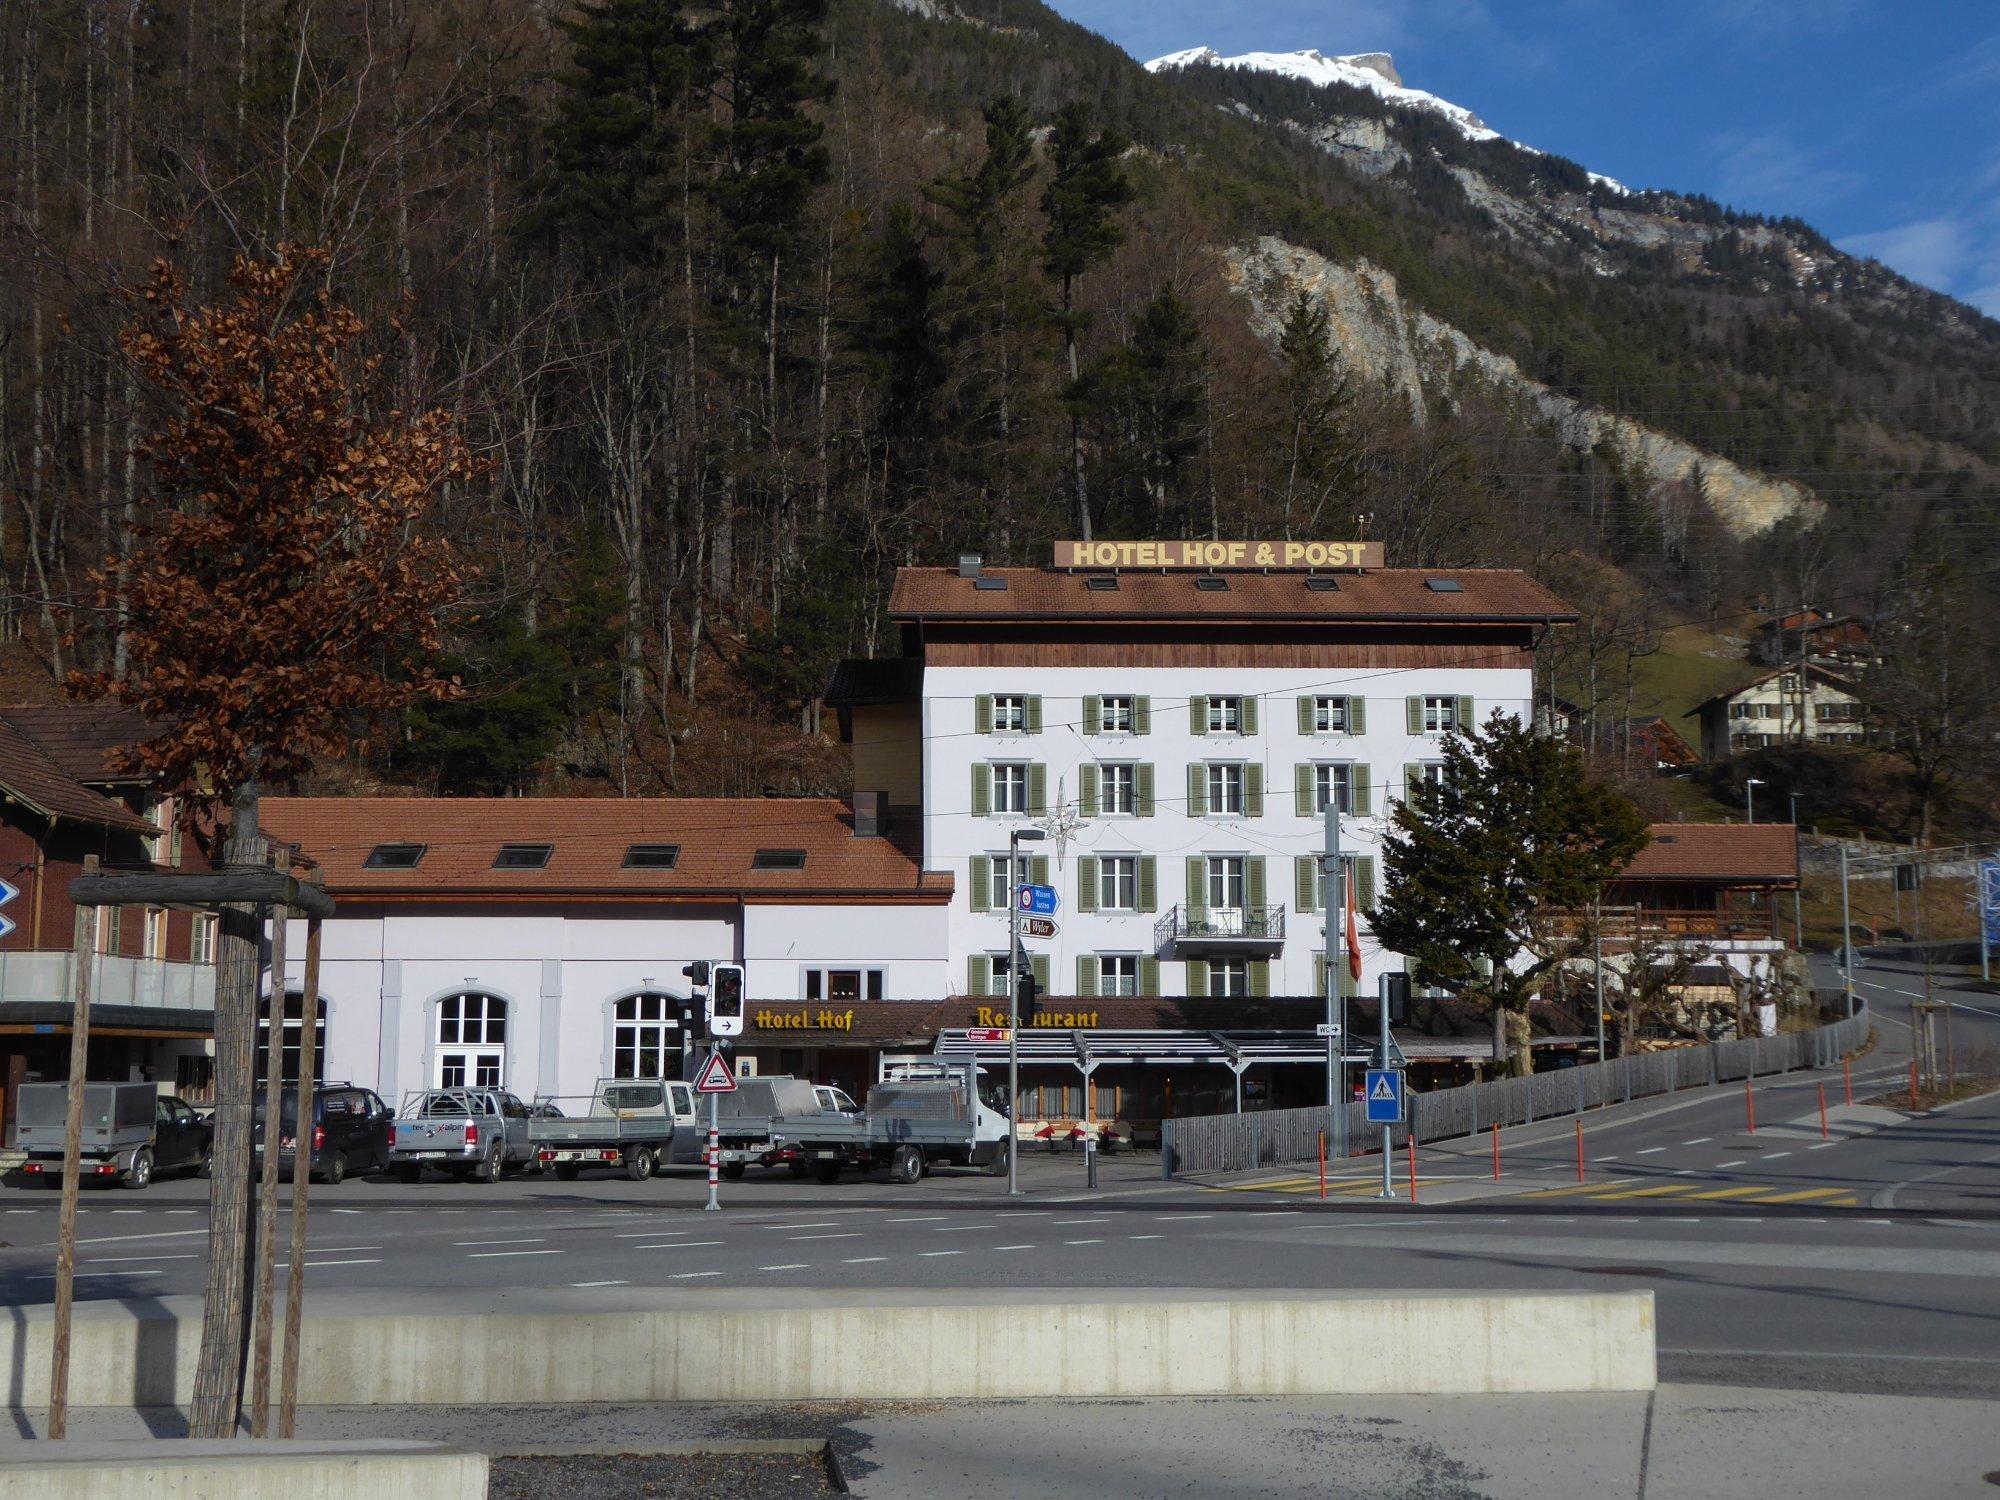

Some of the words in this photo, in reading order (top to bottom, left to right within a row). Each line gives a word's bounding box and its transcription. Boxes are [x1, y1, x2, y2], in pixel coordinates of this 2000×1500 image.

[1073, 542, 1175, 566] HOTEL
[1182, 542, 1247, 566] HOF
[1254, 542, 1277, 566] &
[1285, 542, 1366, 566] POST
[755, 1010, 808, 1029] Hotel
[817, 1009, 854, 1031] Hof
